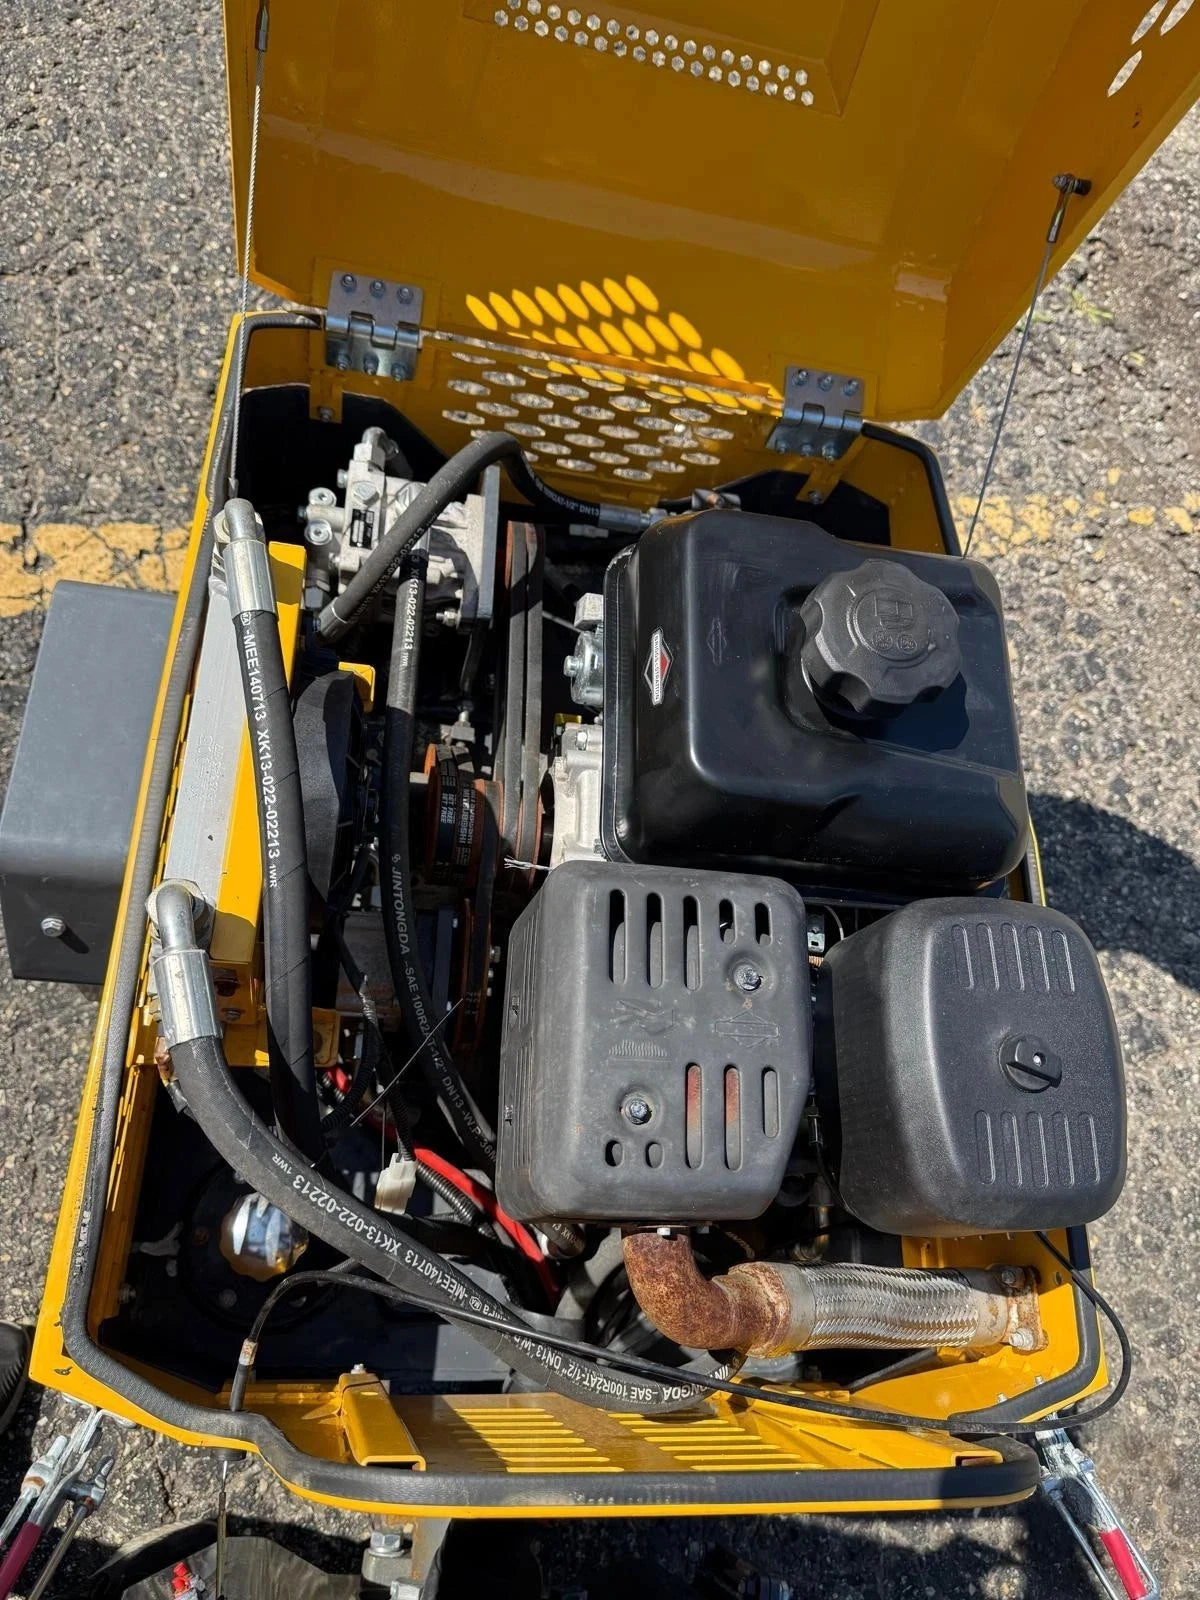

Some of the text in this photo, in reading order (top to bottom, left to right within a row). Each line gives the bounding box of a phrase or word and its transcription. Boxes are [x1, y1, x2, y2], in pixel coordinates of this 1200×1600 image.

[243, 629, 267, 721] -MEE140713
[256, 728, 280, 859] XK13-022-02213
[268, 864, 278, 888] 1WR
[392, 867, 410, 955] JINTONGDA
[441, 1076, 465, 1109] DN13
[271, 1153, 293, 1174] 1WR
[292, 1174, 402, 1256] XK13-022-02213
[405, 1249, 468, 1301] -MEE140713
[536, 1344, 562, 1370] DN13
[562, 1363, 628, 1397] 100R2AT-1/2"
